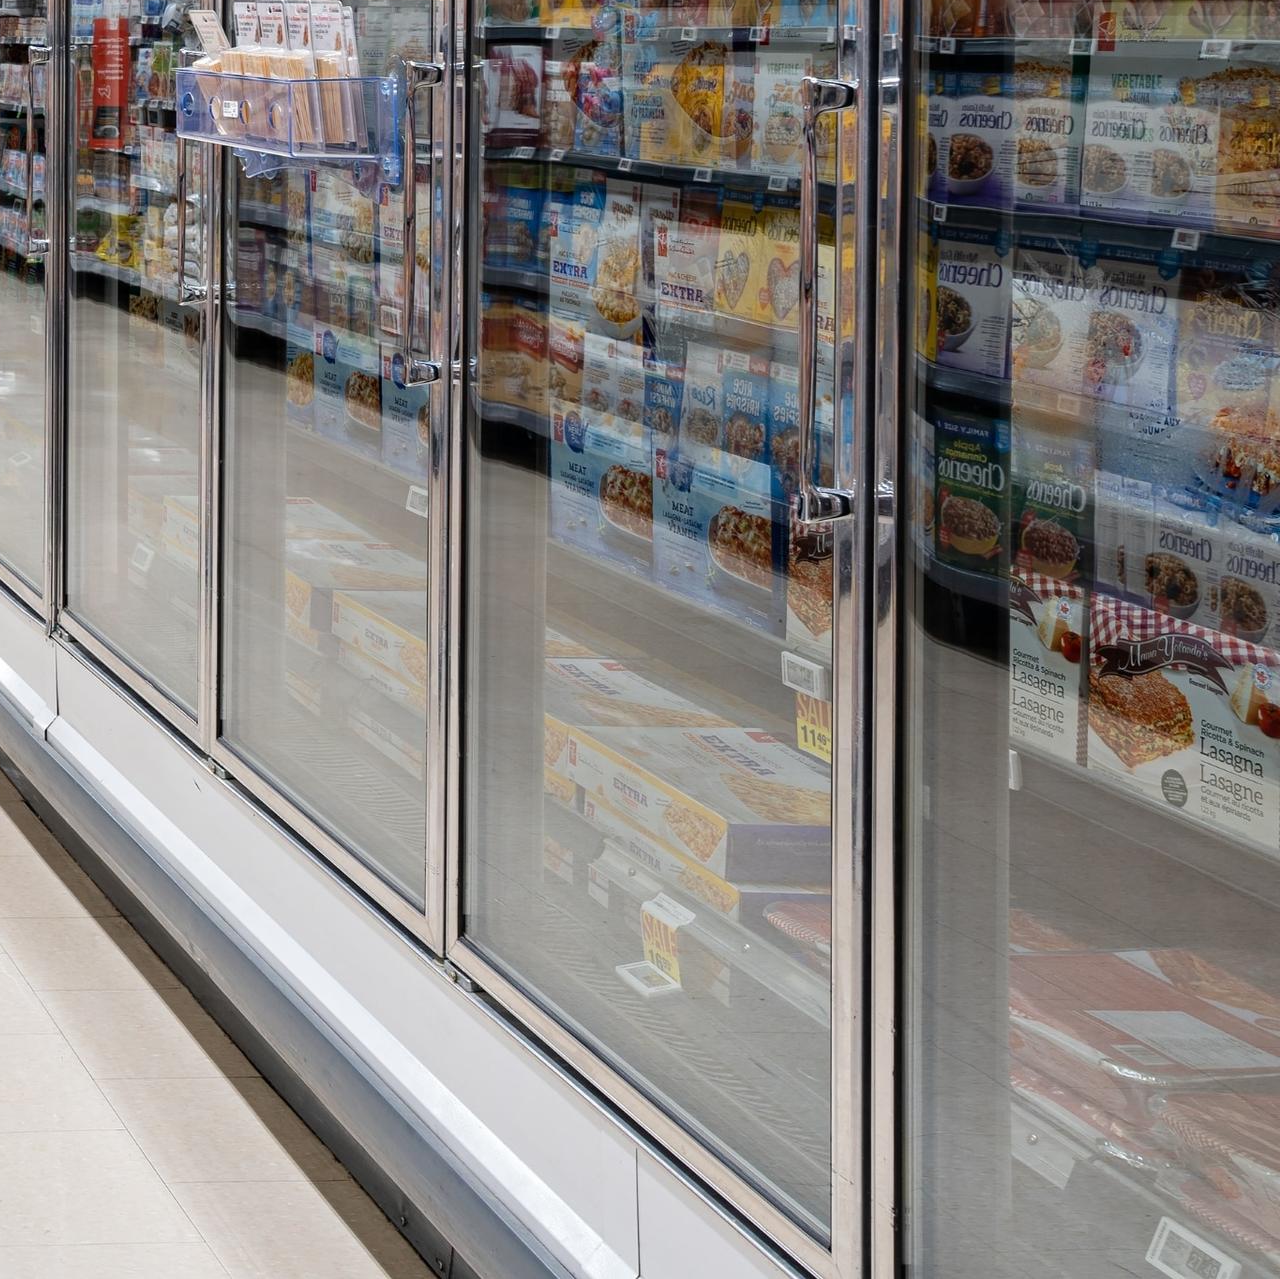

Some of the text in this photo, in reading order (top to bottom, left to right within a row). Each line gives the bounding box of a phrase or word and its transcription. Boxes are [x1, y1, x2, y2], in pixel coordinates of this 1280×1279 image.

[1112, 74, 1162, 90] VEGETABLE
[553, 260, 589, 279] EXTRA
[660, 282, 704, 303] EXTRA
[568, 461, 588, 475] MEAT
[671, 501, 695, 517] MEAT
[1012, 648, 1040, 663] Gourmet
[1011, 663, 1065, 699] Lasagna
[1011, 688, 1065, 725] Lasagne
[1200, 719, 1233, 738] Gourmet
[1199, 736, 1264, 778] Lasagna
[612, 776, 649, 809] EXTRA
[1199, 763, 1264, 807] Lasagne
